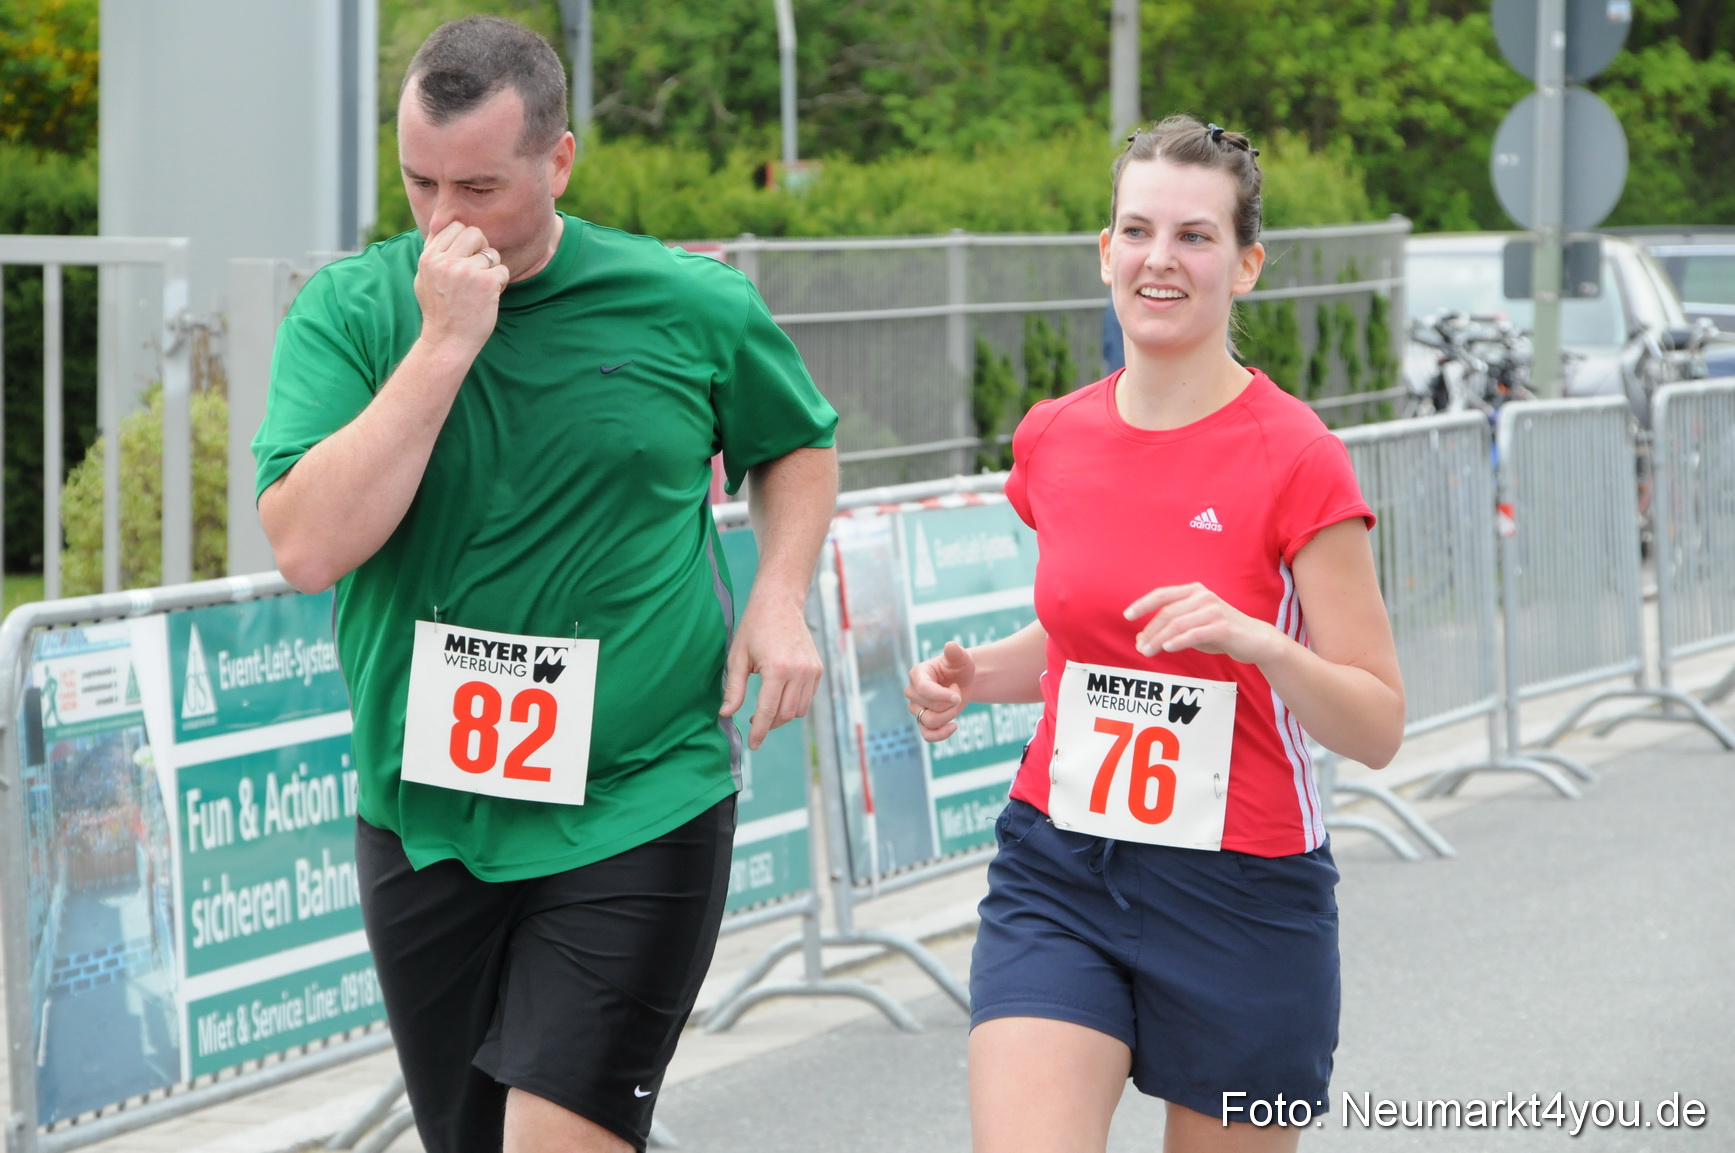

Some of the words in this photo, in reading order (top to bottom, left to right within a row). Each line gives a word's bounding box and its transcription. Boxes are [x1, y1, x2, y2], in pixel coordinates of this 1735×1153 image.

[1190, 519, 1223, 532] adidas
[444, 633, 527, 662] MEYER
[444, 653, 527, 677] WERBUNG
[1087, 673, 1164, 701] MEYER
[1087, 693, 1162, 716] WERBUNG
[449, 681, 558, 782] 82
[1089, 716, 1180, 825] 76
[186, 788, 234, 853] Fun
[239, 777, 260, 841] &
[264, 762, 339, 835] Action
[191, 873, 292, 948] sicheren
[197, 1010, 235, 1057] Miet
[237, 1004, 250, 1045] &
[252, 990, 304, 1041] Service
[305, 981, 339, 1024] Line:
